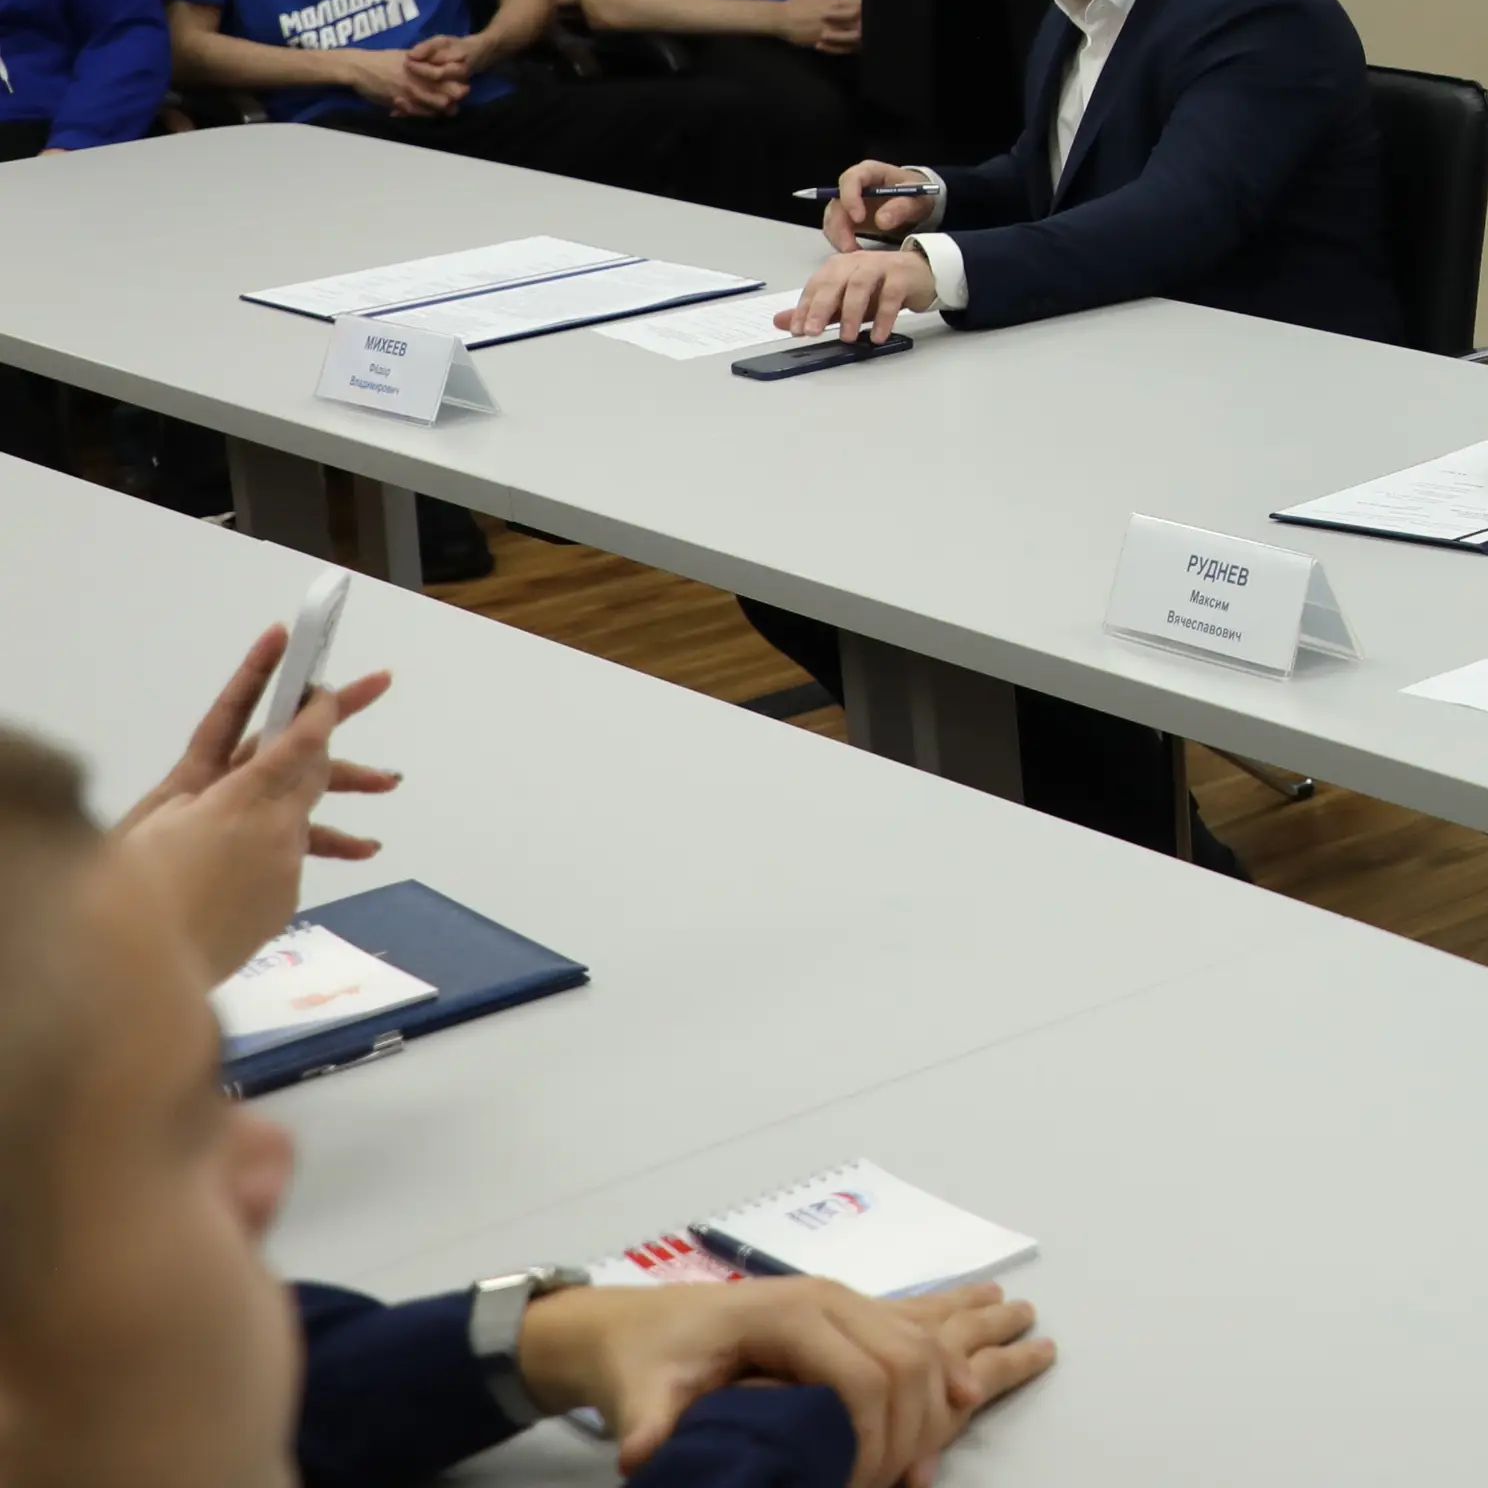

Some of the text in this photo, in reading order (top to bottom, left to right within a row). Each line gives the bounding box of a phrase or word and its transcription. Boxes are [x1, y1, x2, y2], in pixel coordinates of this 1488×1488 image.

[364, 335, 408, 357] МИХЕЕВ
[1187, 554, 1250, 587] РУДНЕВ
[1189, 590, 1230, 612] Максим
[1167, 610, 1242, 641] Вячеславович
